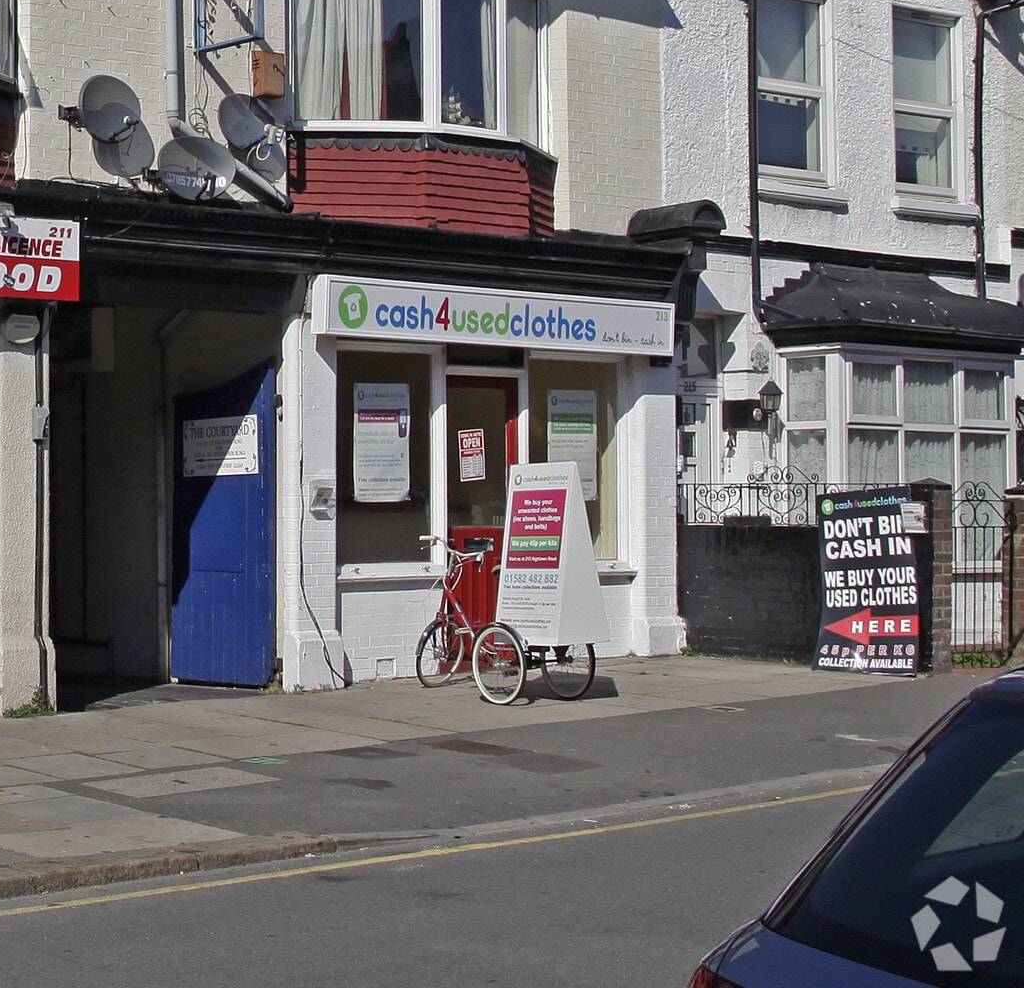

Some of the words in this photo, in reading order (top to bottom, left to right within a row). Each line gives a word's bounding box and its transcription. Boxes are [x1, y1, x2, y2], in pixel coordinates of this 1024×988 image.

[49, 227, 73, 239] 211
[375, 295, 596, 342] cash4usedclothes
[656, 311, 668, 322] 213
[190, 427, 204, 439] THE
[206, 424, 250, 438] COURTYARD
[462, 437, 481, 448] OPEN
[824, 516, 874, 539] DON'T
[826, 538, 882, 560] CASH
[888, 536, 912, 556] IN
[504, 574, 526, 584] 01582
[528, 574, 543, 584] 482
[824, 570, 845, 588] WE
[848, 568, 875, 587] BUY
[877, 566, 917, 585] YOUR
[826, 588, 858, 608] USED
[860, 586, 917, 607] CLOTHES
[851, 619, 911, 634] HERE
[856, 644, 888, 656] PER
[893, 644, 915, 656] KG
[818, 657, 868, 669] COLLECTION
[870, 658, 914, 669] AVAILABLE
